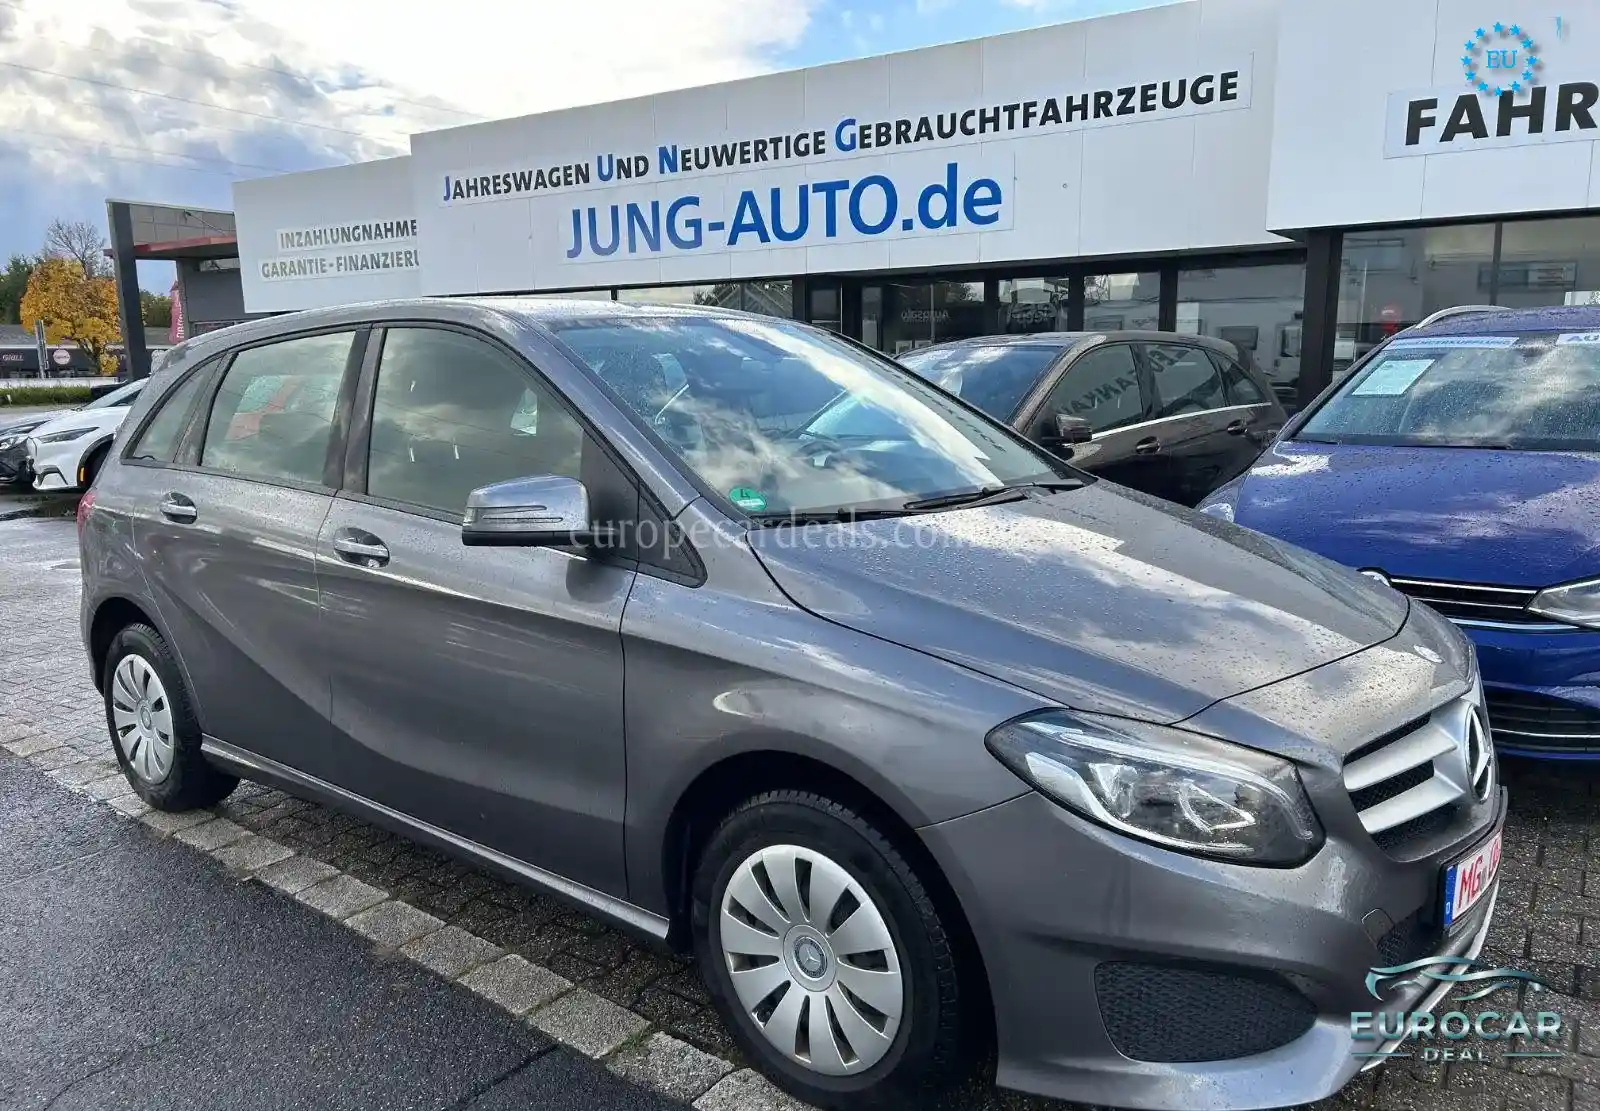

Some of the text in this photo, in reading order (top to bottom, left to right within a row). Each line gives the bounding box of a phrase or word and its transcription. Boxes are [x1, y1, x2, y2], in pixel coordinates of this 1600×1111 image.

[443, 70, 1239, 201] JAHRESWAGEN UND NEUWERTIGE GEBRAUCHTFAHRZEUGE
[1405, 81, 1599, 146] FAHR
[280, 219, 417, 249] INZAHLUNGNAHME
[566, 163, 1002, 259] JUNG-AUTO.de
[1458, 855, 1484, 909] MG
